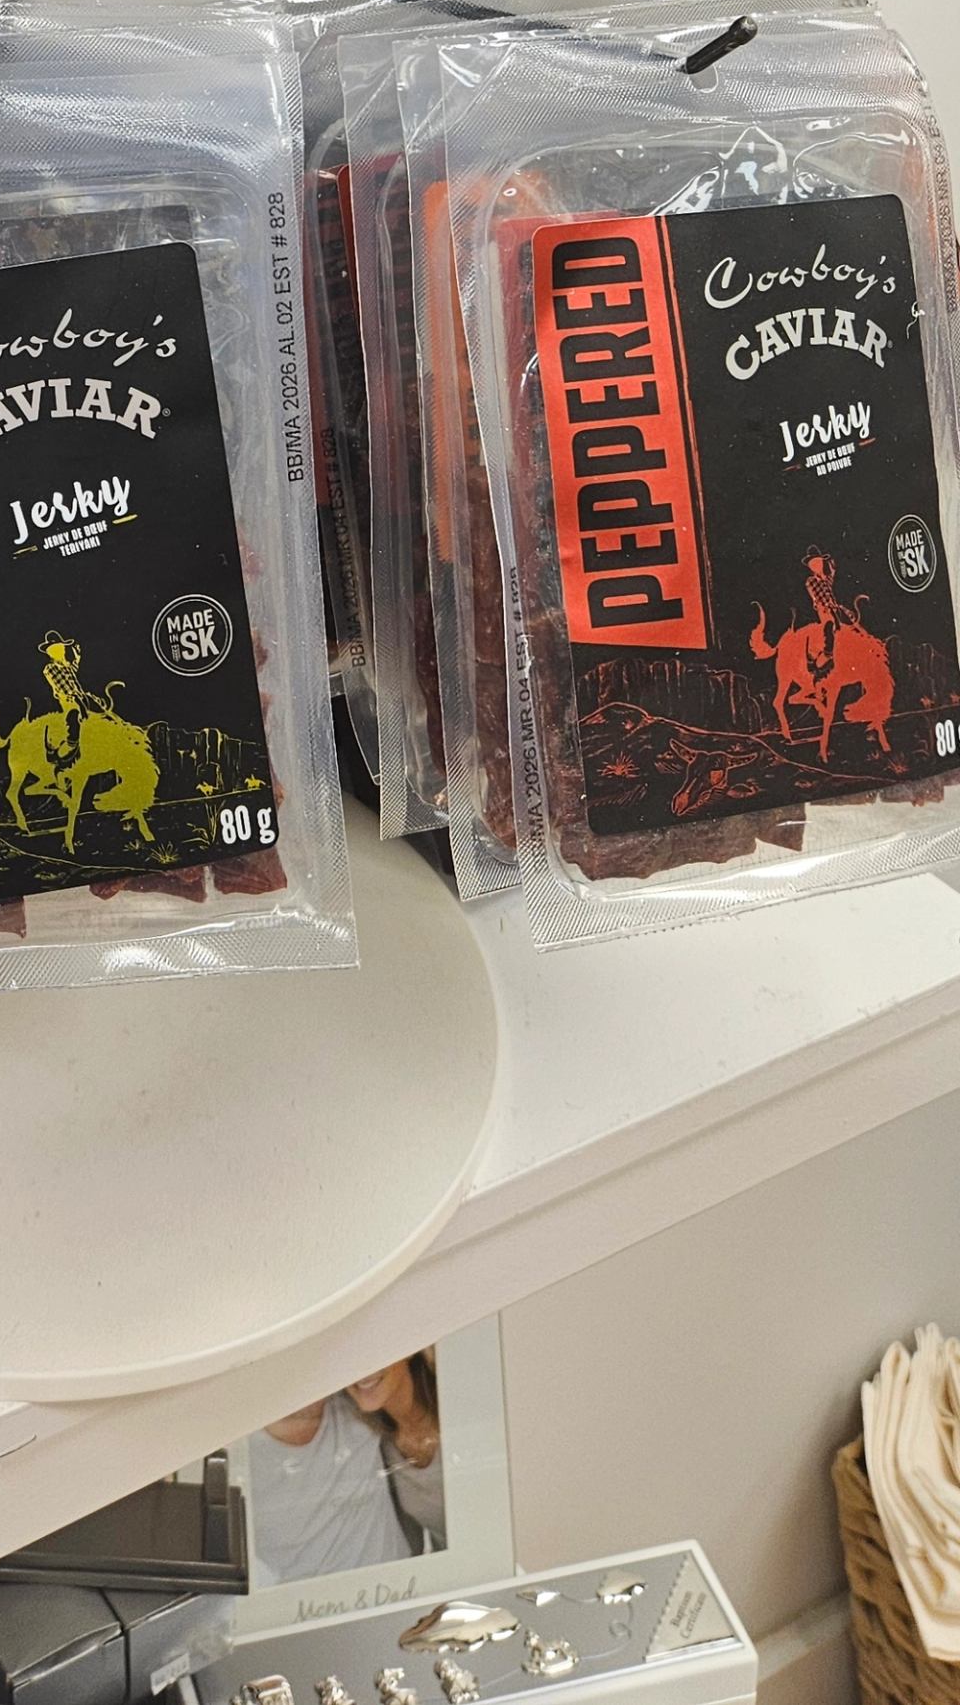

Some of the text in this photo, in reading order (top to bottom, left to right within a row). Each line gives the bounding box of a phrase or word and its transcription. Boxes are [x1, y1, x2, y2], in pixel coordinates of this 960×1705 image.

[268, 191, 286, 223] 828
[270, 229, 288, 247] #
[273, 250, 292, 294] EST
[704, 243, 896, 310] Cowboy's
[725, 307, 888, 381] CAVIAR
[286, 414, 305, 483] BB/MA
[551, 235, 683, 630] PEPPERED
[779, 401, 871, 463] Jerky
[805, 453, 826, 468] JERKY
[10, 476, 130, 545] Jerky
[43, 531, 70, 550] JERKY
[71, 528, 83, 541] DE
[59, 536, 101, 557] TERIYAKI
[895, 529, 924, 551] MADE
[905, 547, 930, 579] SK
[166, 608, 215, 634] MADE
[168, 624, 220, 662] IN SK
[348, 613, 367, 669] BB/MA
[935, 719, 957, 758] 80
[220, 805, 276, 845] 80 g
[292, 1576, 418, 1624] Mom & Dad
